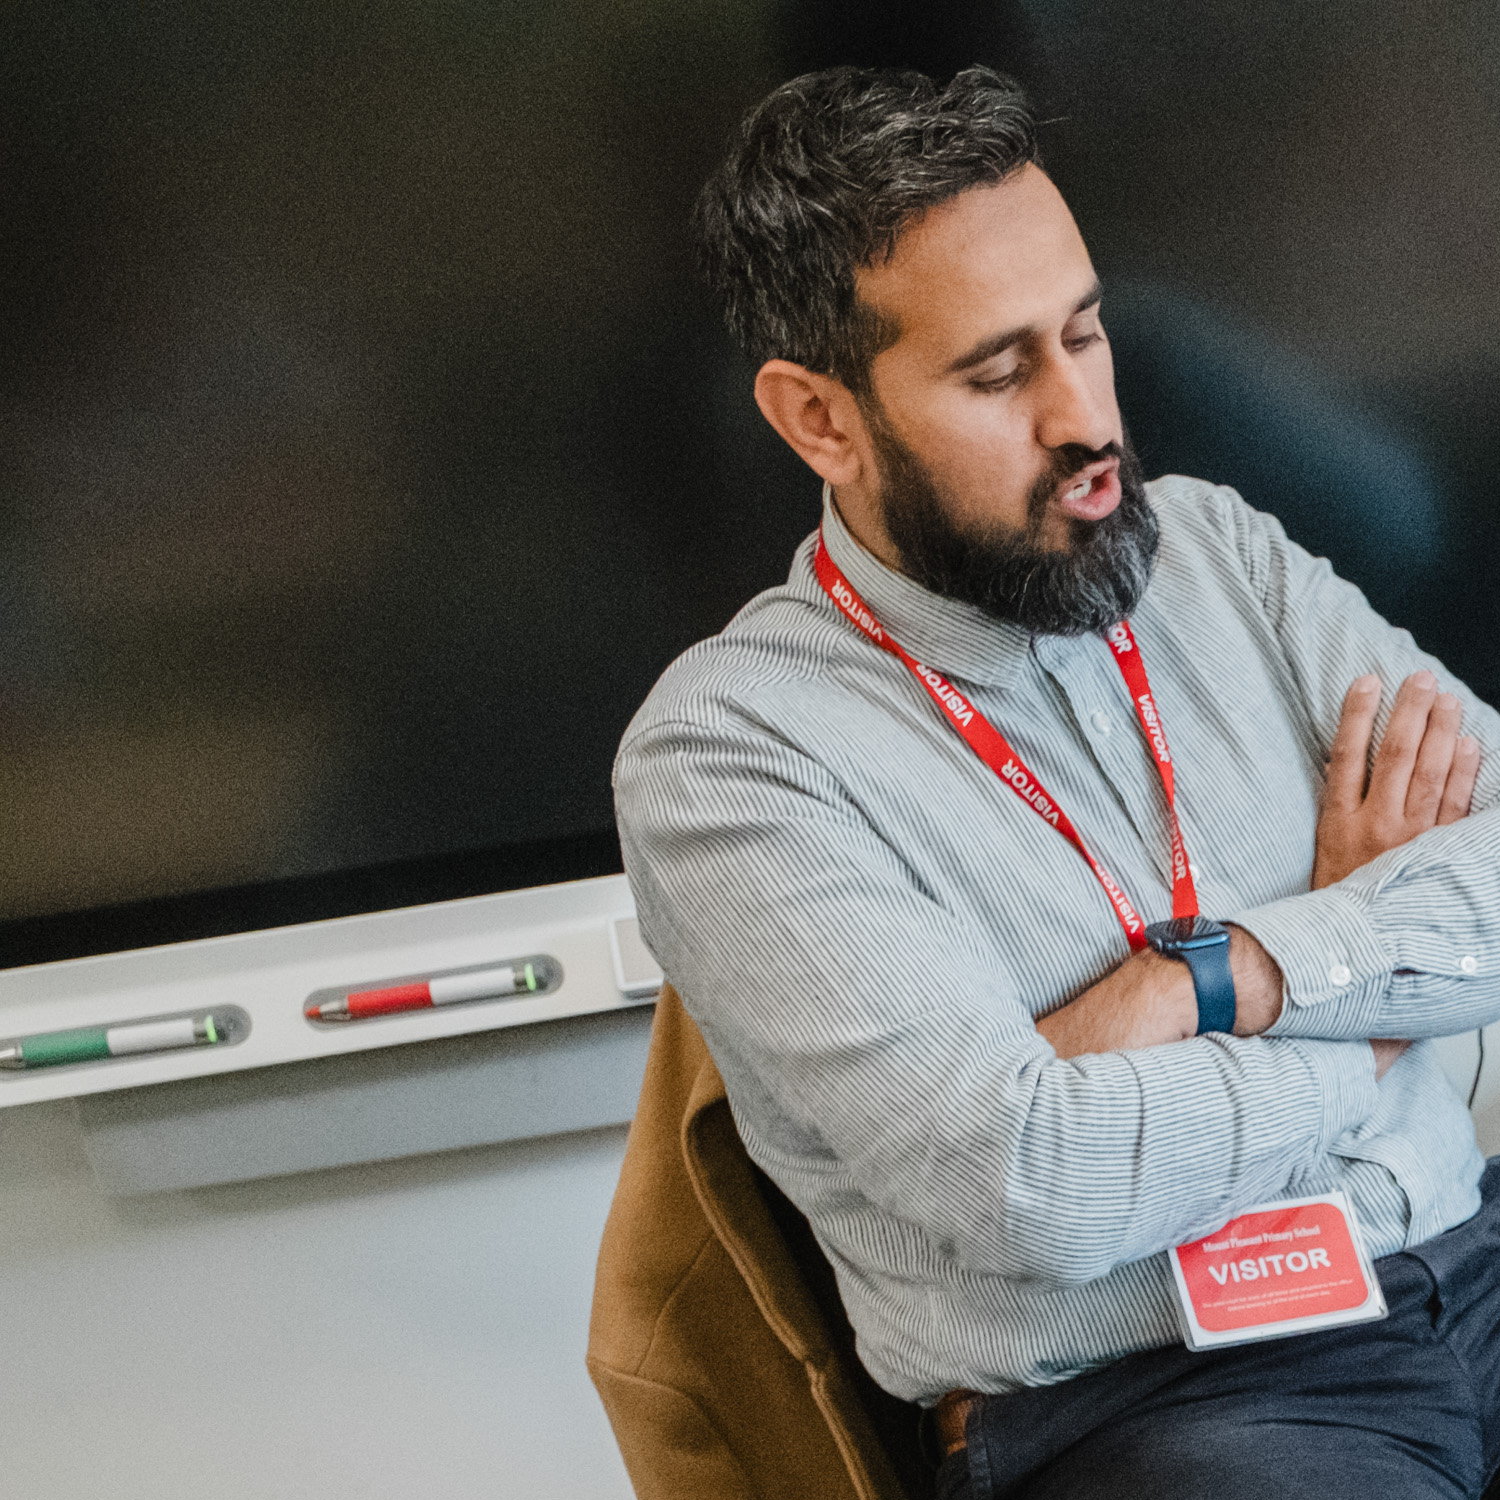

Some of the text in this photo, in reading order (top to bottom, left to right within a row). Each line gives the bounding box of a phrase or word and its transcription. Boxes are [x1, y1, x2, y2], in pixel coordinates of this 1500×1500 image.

[831, 579, 884, 641] VISITOR
[916, 663, 974, 727] VISITOR
[1137, 693, 1171, 764] VISITOR
[1001, 757, 1060, 826] VISITOR
[1095, 863, 1140, 934] VISITOR
[1263, 1229, 1294, 1243] Primary
[1294, 1224, 1321, 1239] School
[1208, 1247, 1331, 1286] VISITOR
